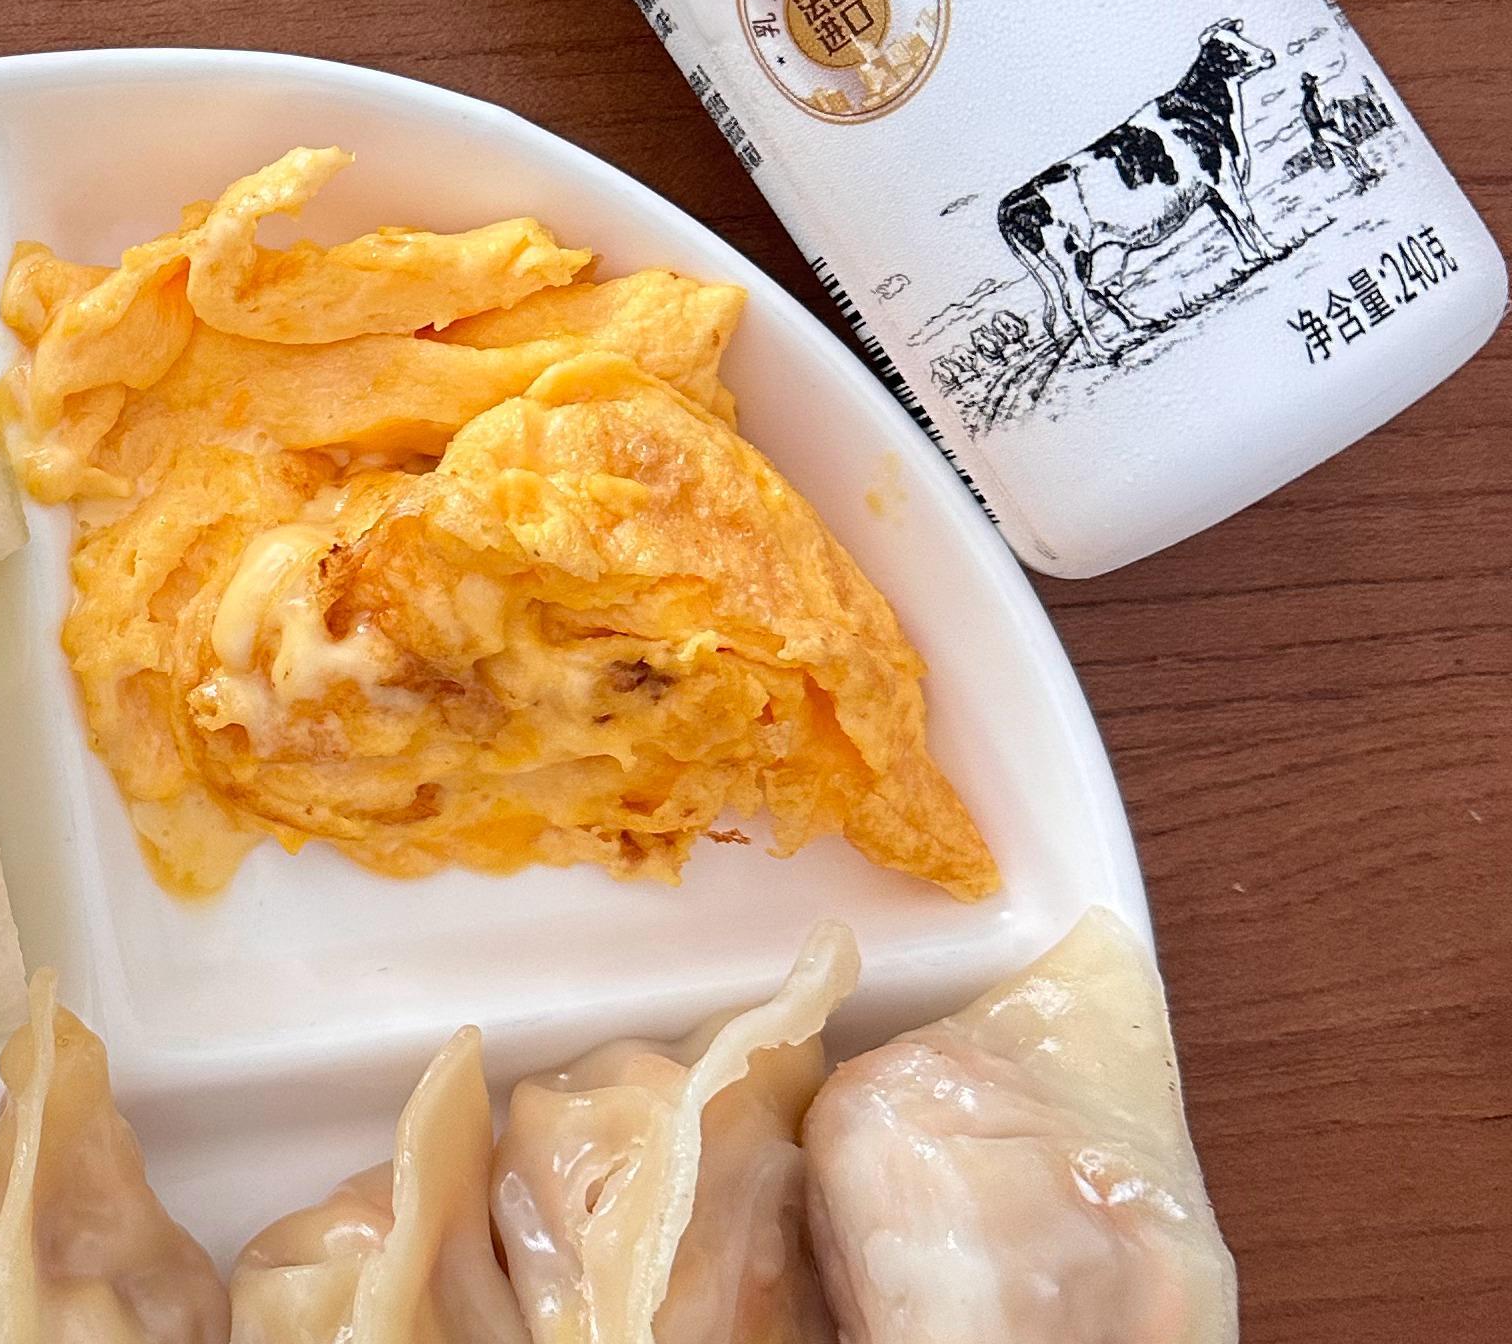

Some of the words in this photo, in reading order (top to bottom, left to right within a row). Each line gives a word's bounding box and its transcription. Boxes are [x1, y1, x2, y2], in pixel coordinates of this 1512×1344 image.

[814, 0, 874, 56] 进口
[1287, 225, 1459, 364] 净含量:240克
